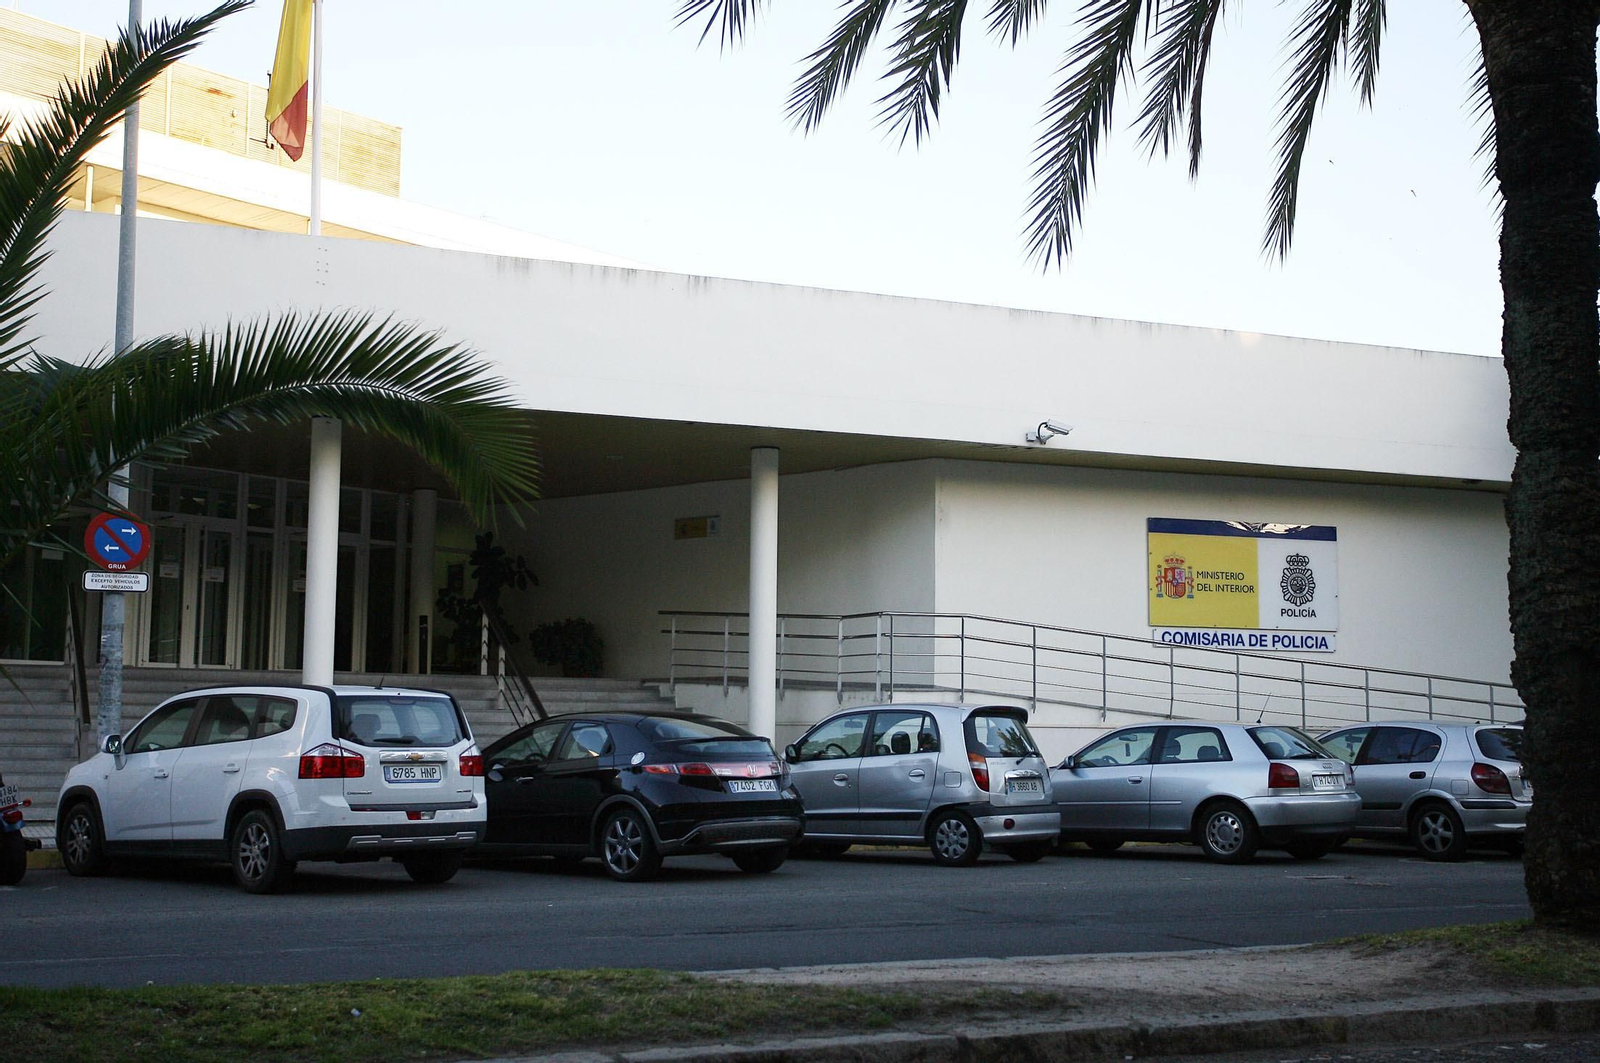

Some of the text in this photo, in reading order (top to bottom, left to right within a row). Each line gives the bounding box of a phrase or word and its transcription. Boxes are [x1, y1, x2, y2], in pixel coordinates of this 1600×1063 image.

[1196, 570, 1245, 581] MINISTERIO
[1196, 583, 1255, 593] DEL INTERIOR
[1280, 607, 1317, 618] POLICÍA
[1161, 631, 1329, 650] COMISARIA DE POLICIA
[392, 767, 437, 779] 6785 HNP
[735, 780, 775, 791] 7402 FGK
